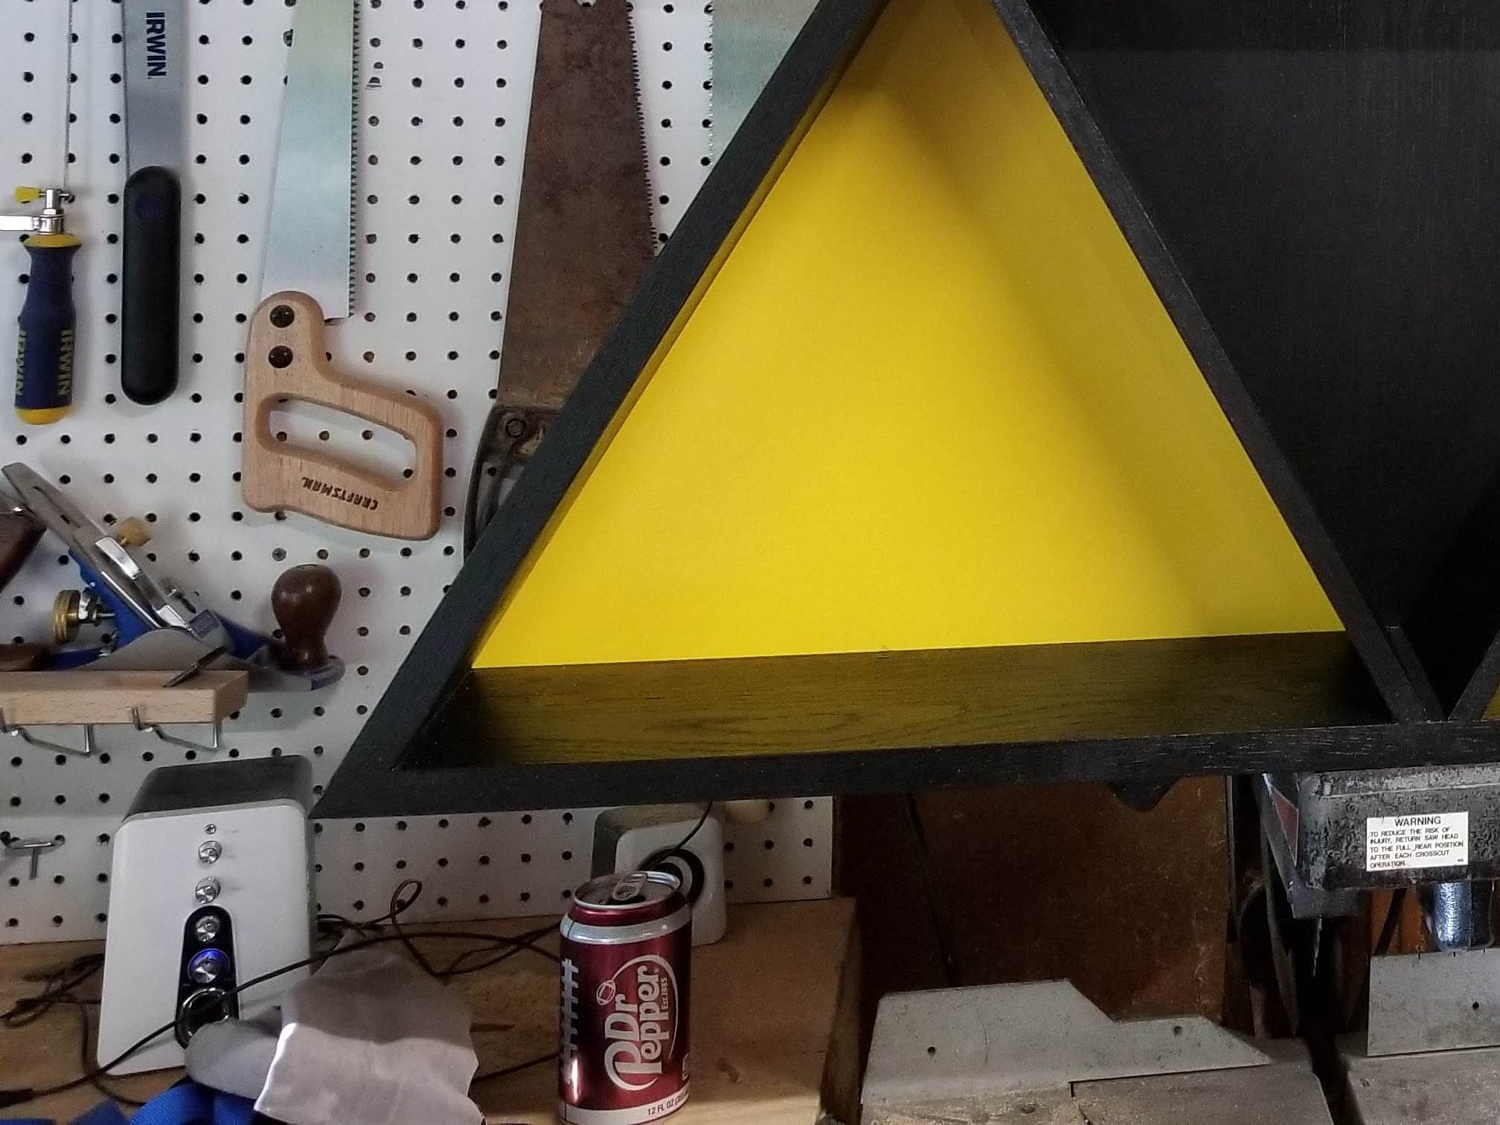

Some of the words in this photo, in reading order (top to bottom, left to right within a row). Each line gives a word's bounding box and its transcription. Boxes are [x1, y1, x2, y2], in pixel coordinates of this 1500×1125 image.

[145, 11, 167, 77] IRWIN
[58, 329, 74, 396] IRWIN
[302, 476, 379, 511] CRAFTSMAN
[1381, 829, 1406, 837] REDUCE
[1394, 816, 1442, 827] WARNING
[1414, 843, 1432, 851] REAR
[1435, 840, 1464, 849] POSITION
[1415, 849, 1450, 857] CROSSCUT
[604, 993, 640, 1042] Dr
[604, 964, 670, 1091] Pepper
[647, 1107, 656, 1115] 12
[657, 1103, 665, 1113] FL
[666, 1098, 674, 1109] OZ
